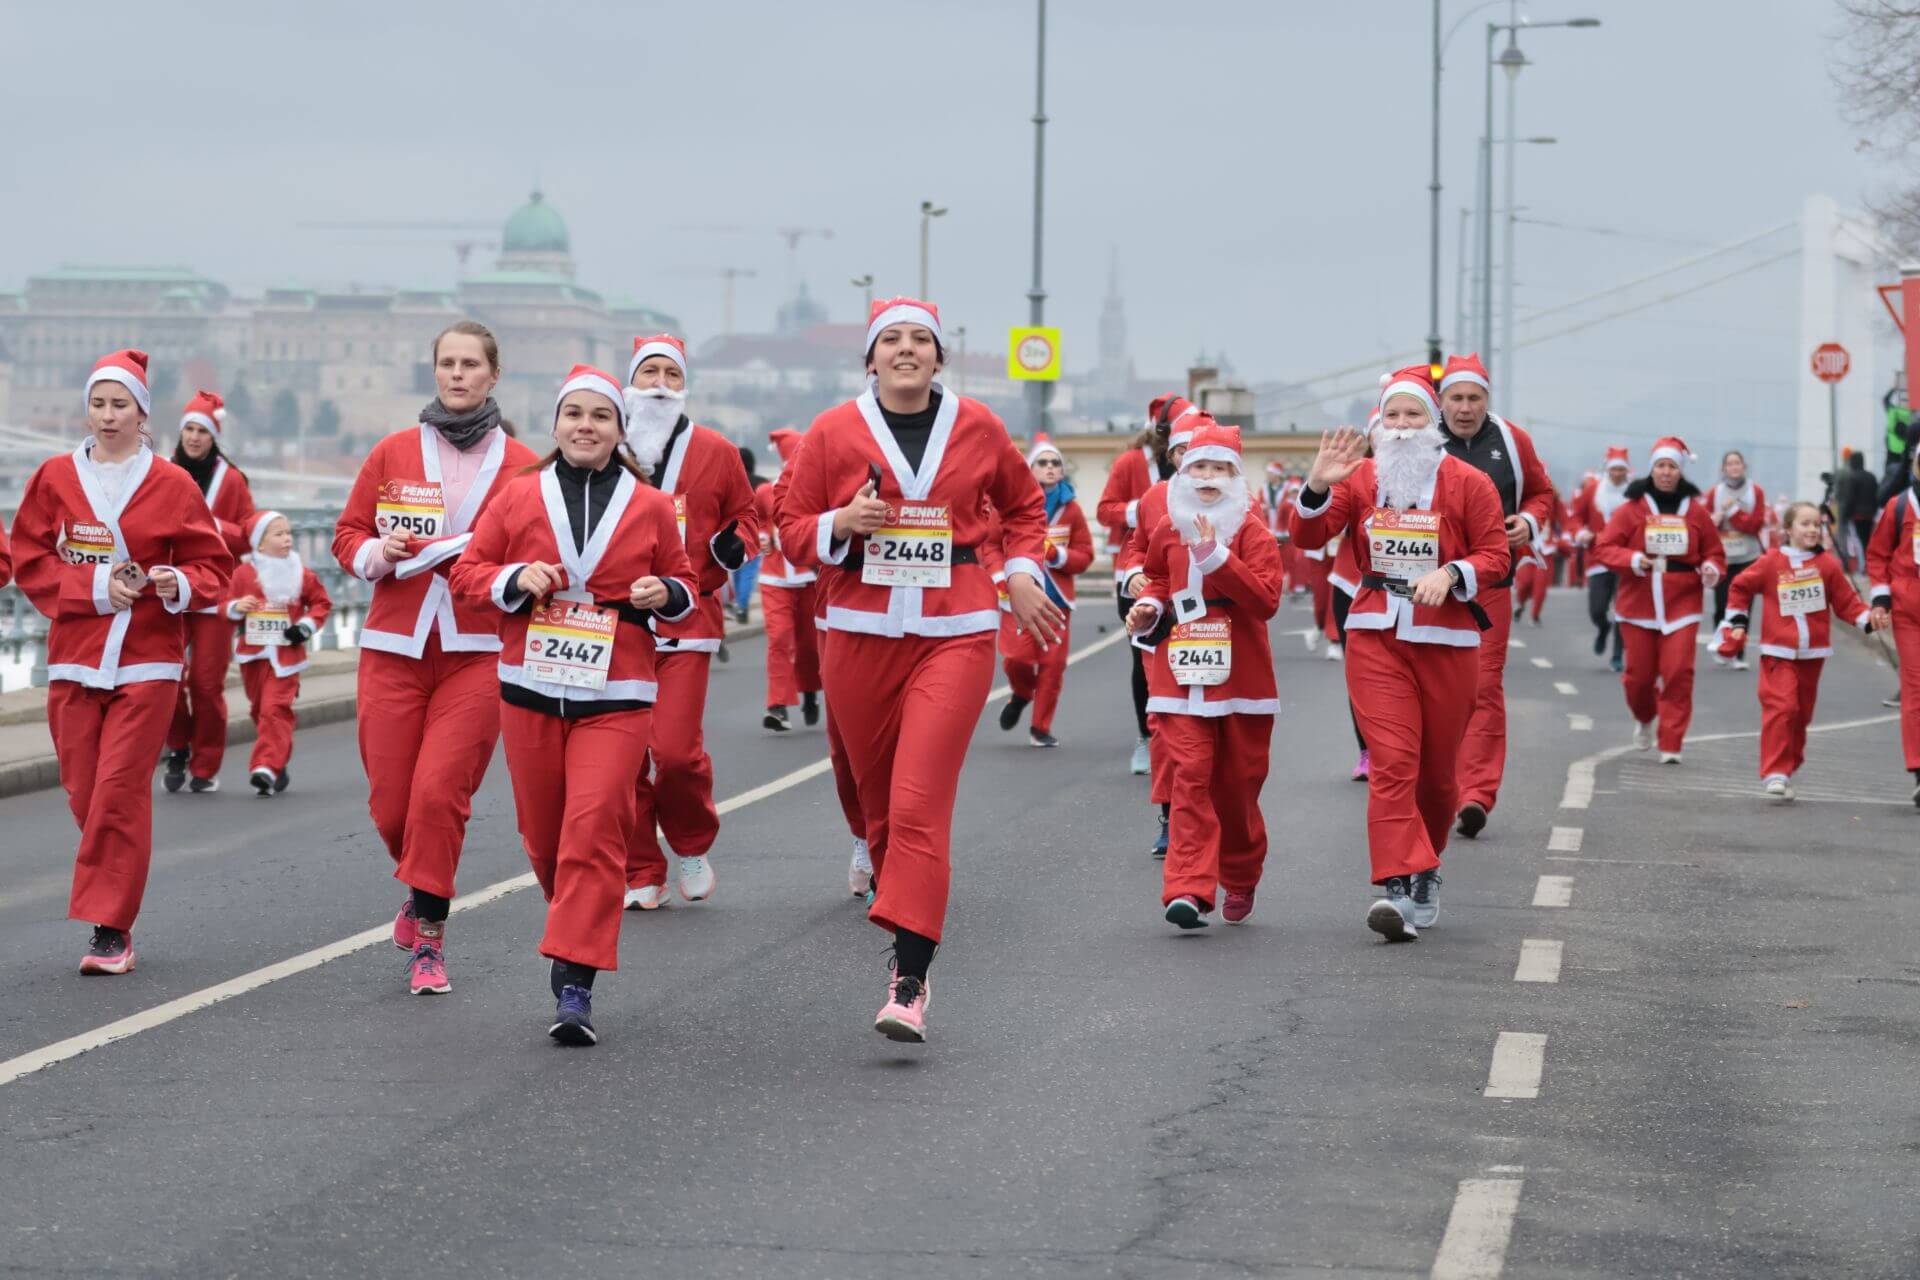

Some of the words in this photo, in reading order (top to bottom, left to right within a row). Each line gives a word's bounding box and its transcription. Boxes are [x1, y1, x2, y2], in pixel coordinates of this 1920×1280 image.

[1814, 351, 1849, 373] STOP
[390, 515, 436, 536] 2950
[1656, 533, 1683, 544] 2391
[884, 540, 944, 562] 2448
[1385, 539, 1433, 557] 2444
[1791, 586, 1821, 601] 2915
[257, 620, 288, 632] 3310
[545, 638, 605, 665] 2447
[1178, 650, 1225, 666] 2441
